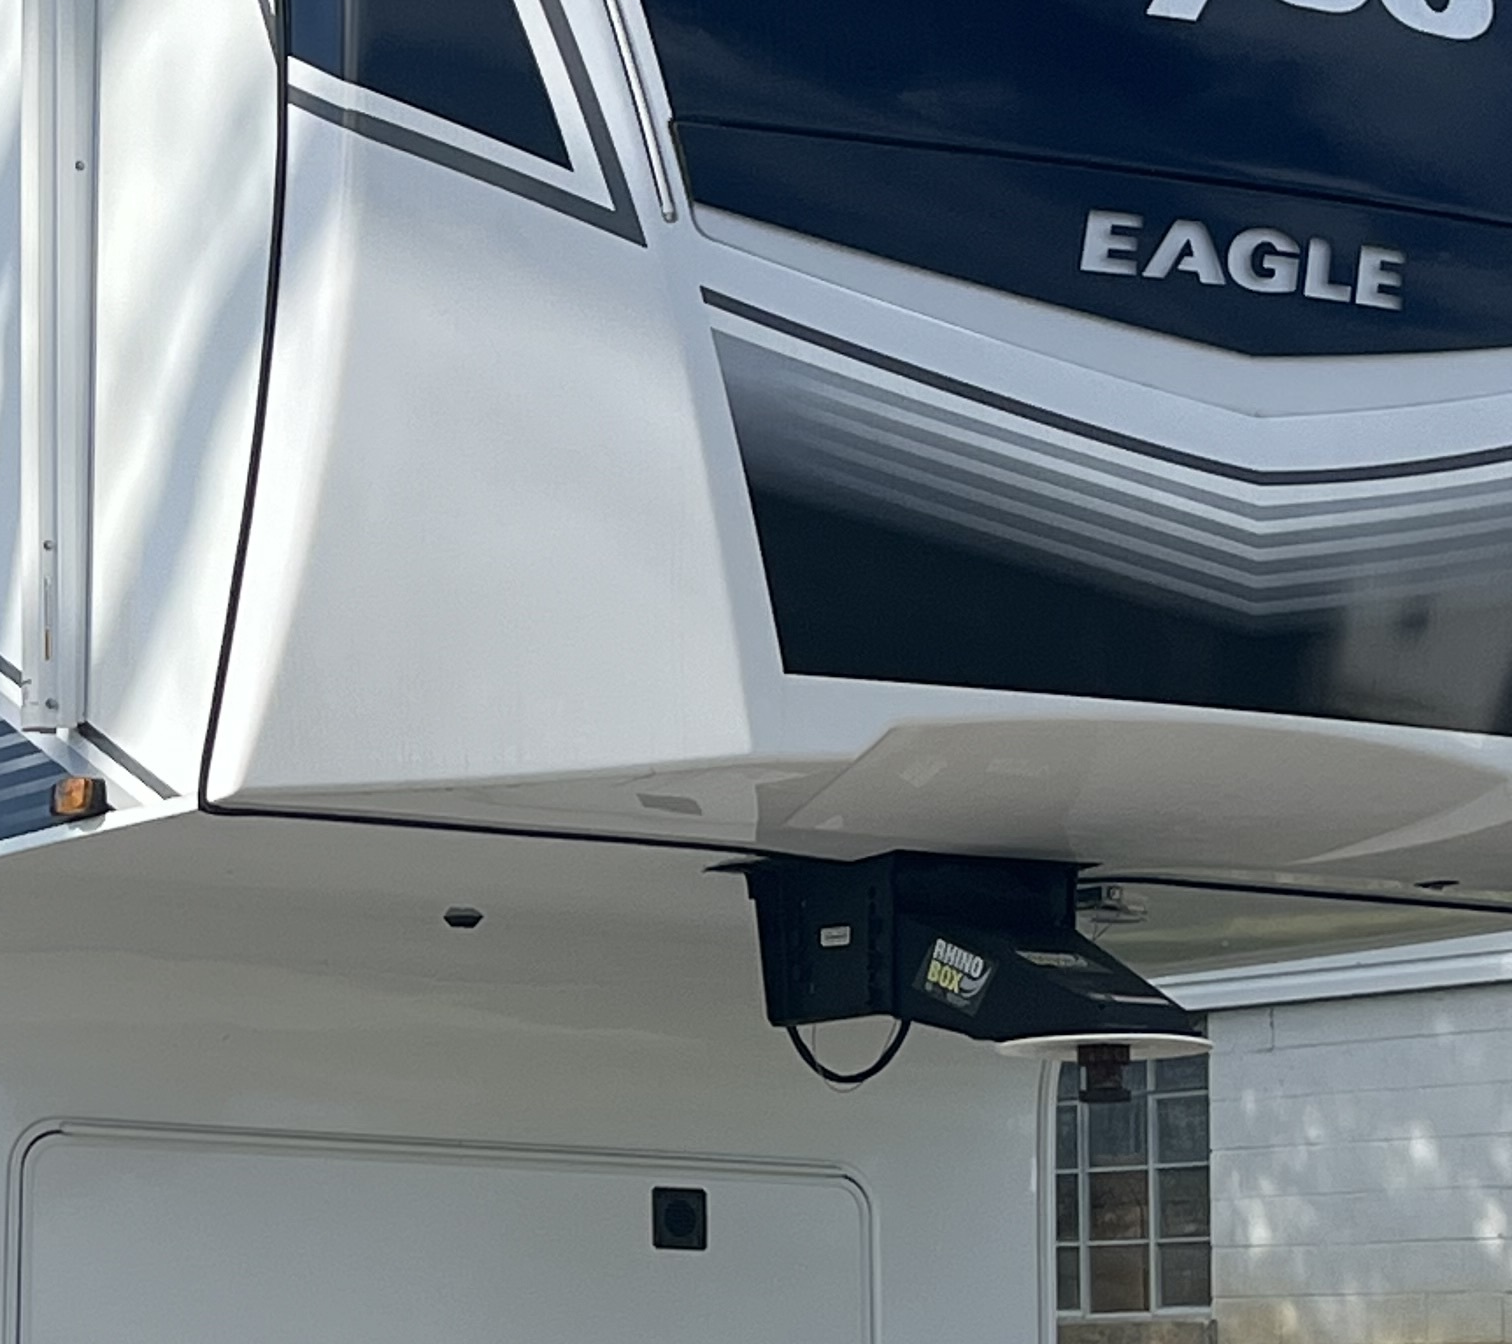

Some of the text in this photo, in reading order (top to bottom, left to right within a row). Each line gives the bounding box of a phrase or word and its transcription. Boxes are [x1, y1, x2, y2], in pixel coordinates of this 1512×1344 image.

[1079, 209, 1406, 311] EAGLE
[927, 959, 964, 994] BOX
[932, 938, 984, 978] RHINO
